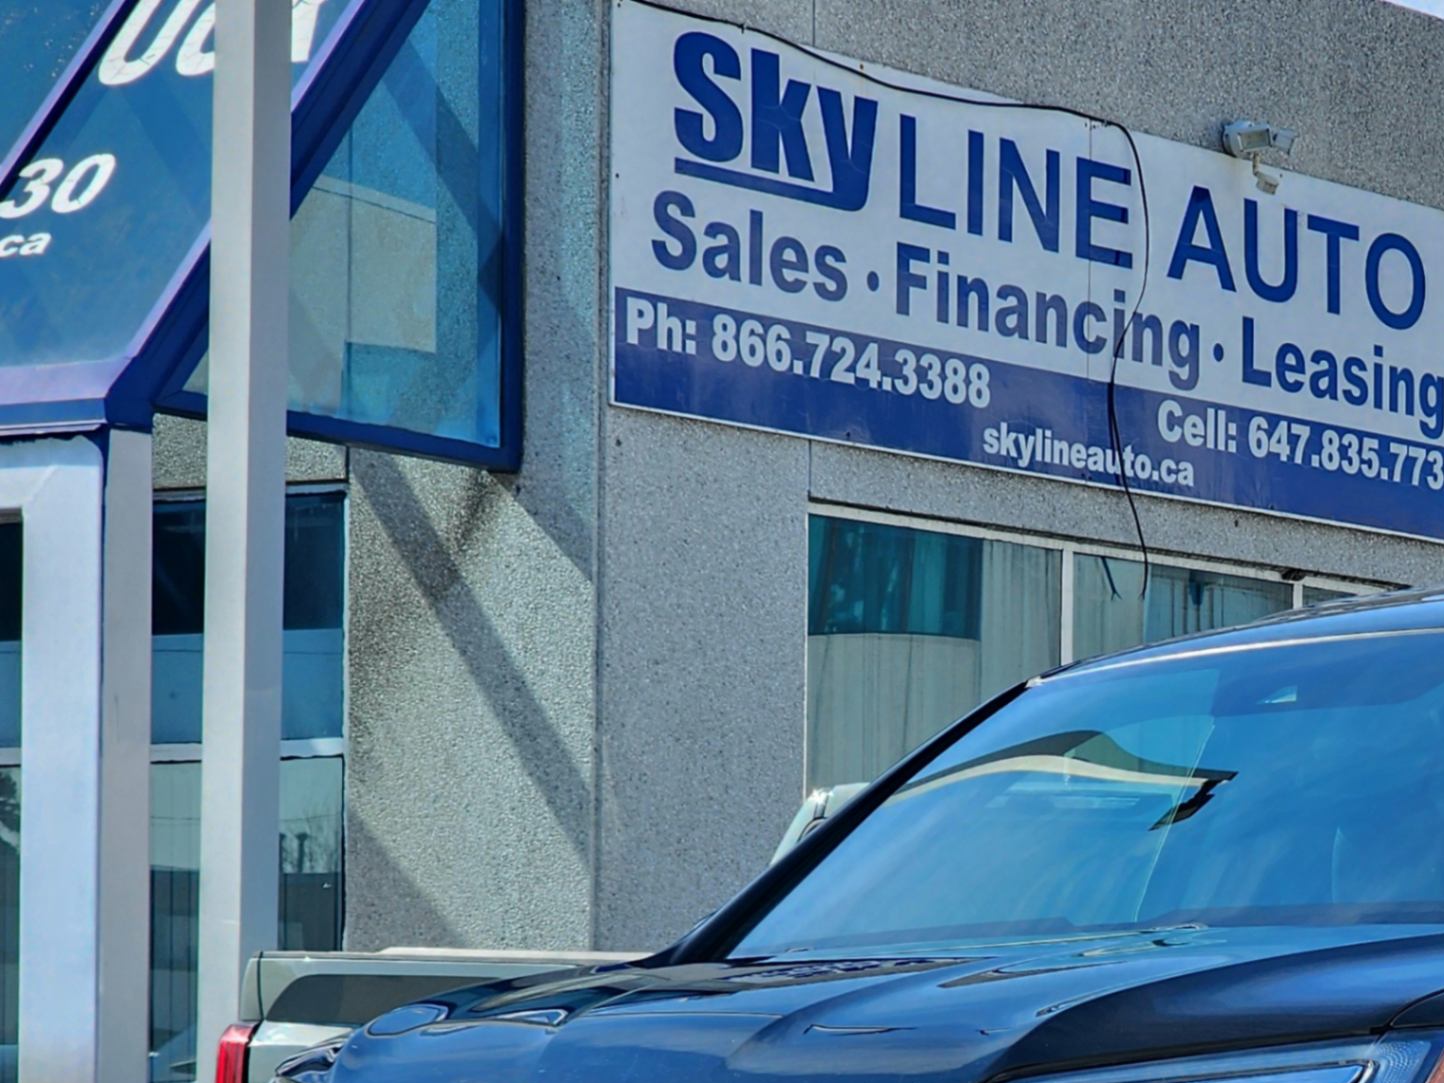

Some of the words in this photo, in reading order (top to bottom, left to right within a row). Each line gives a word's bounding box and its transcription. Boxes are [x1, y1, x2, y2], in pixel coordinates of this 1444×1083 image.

[651, 190, 848, 302] Sales
[896, 240, 1200, 391] Financing
[1167, 185, 1427, 330] AUTO
[626, 297, 697, 355] Ph:
[711, 314, 991, 408] 866.724.3388
[982, 422, 1194, 487] skylineauto.ca
[1157, 400, 1238, 453] Cell:
